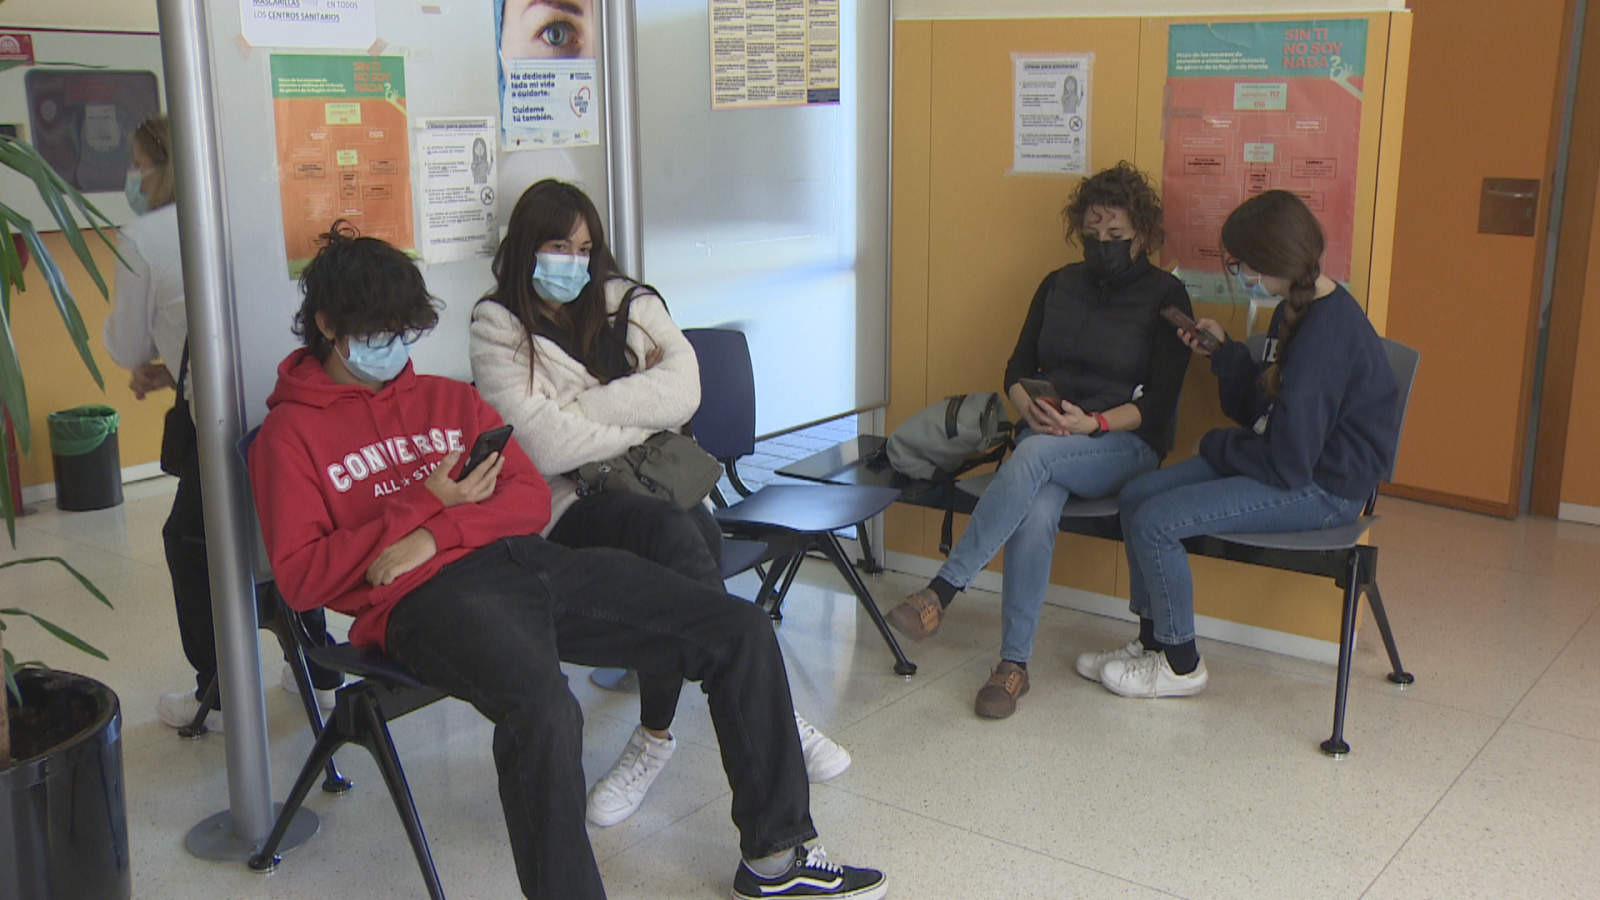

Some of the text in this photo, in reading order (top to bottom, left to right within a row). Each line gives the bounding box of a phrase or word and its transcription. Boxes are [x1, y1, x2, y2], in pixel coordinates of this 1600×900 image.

[327, 1, 336, 9] EN
[337, 1, 358, 9] TODOS
[254, 10, 340, 22] LOS CENTROS SANITARIOS
[1284, 27, 1328, 41] SIN TI
[1283, 41, 1343, 56] NO SOY
[353, 61, 381, 71] SIN TI
[354, 72, 391, 82] NO SOY
[510, 71, 556, 80] Ha dedicado
[511, 81, 528, 89] toda
[529, 81, 539, 89] mi
[517, 89, 550, 97] cuidarte.
[513, 113, 554, 122] tú también.
[327, 427, 466, 493] CONVERSE
[374, 479, 401, 498] ALL
